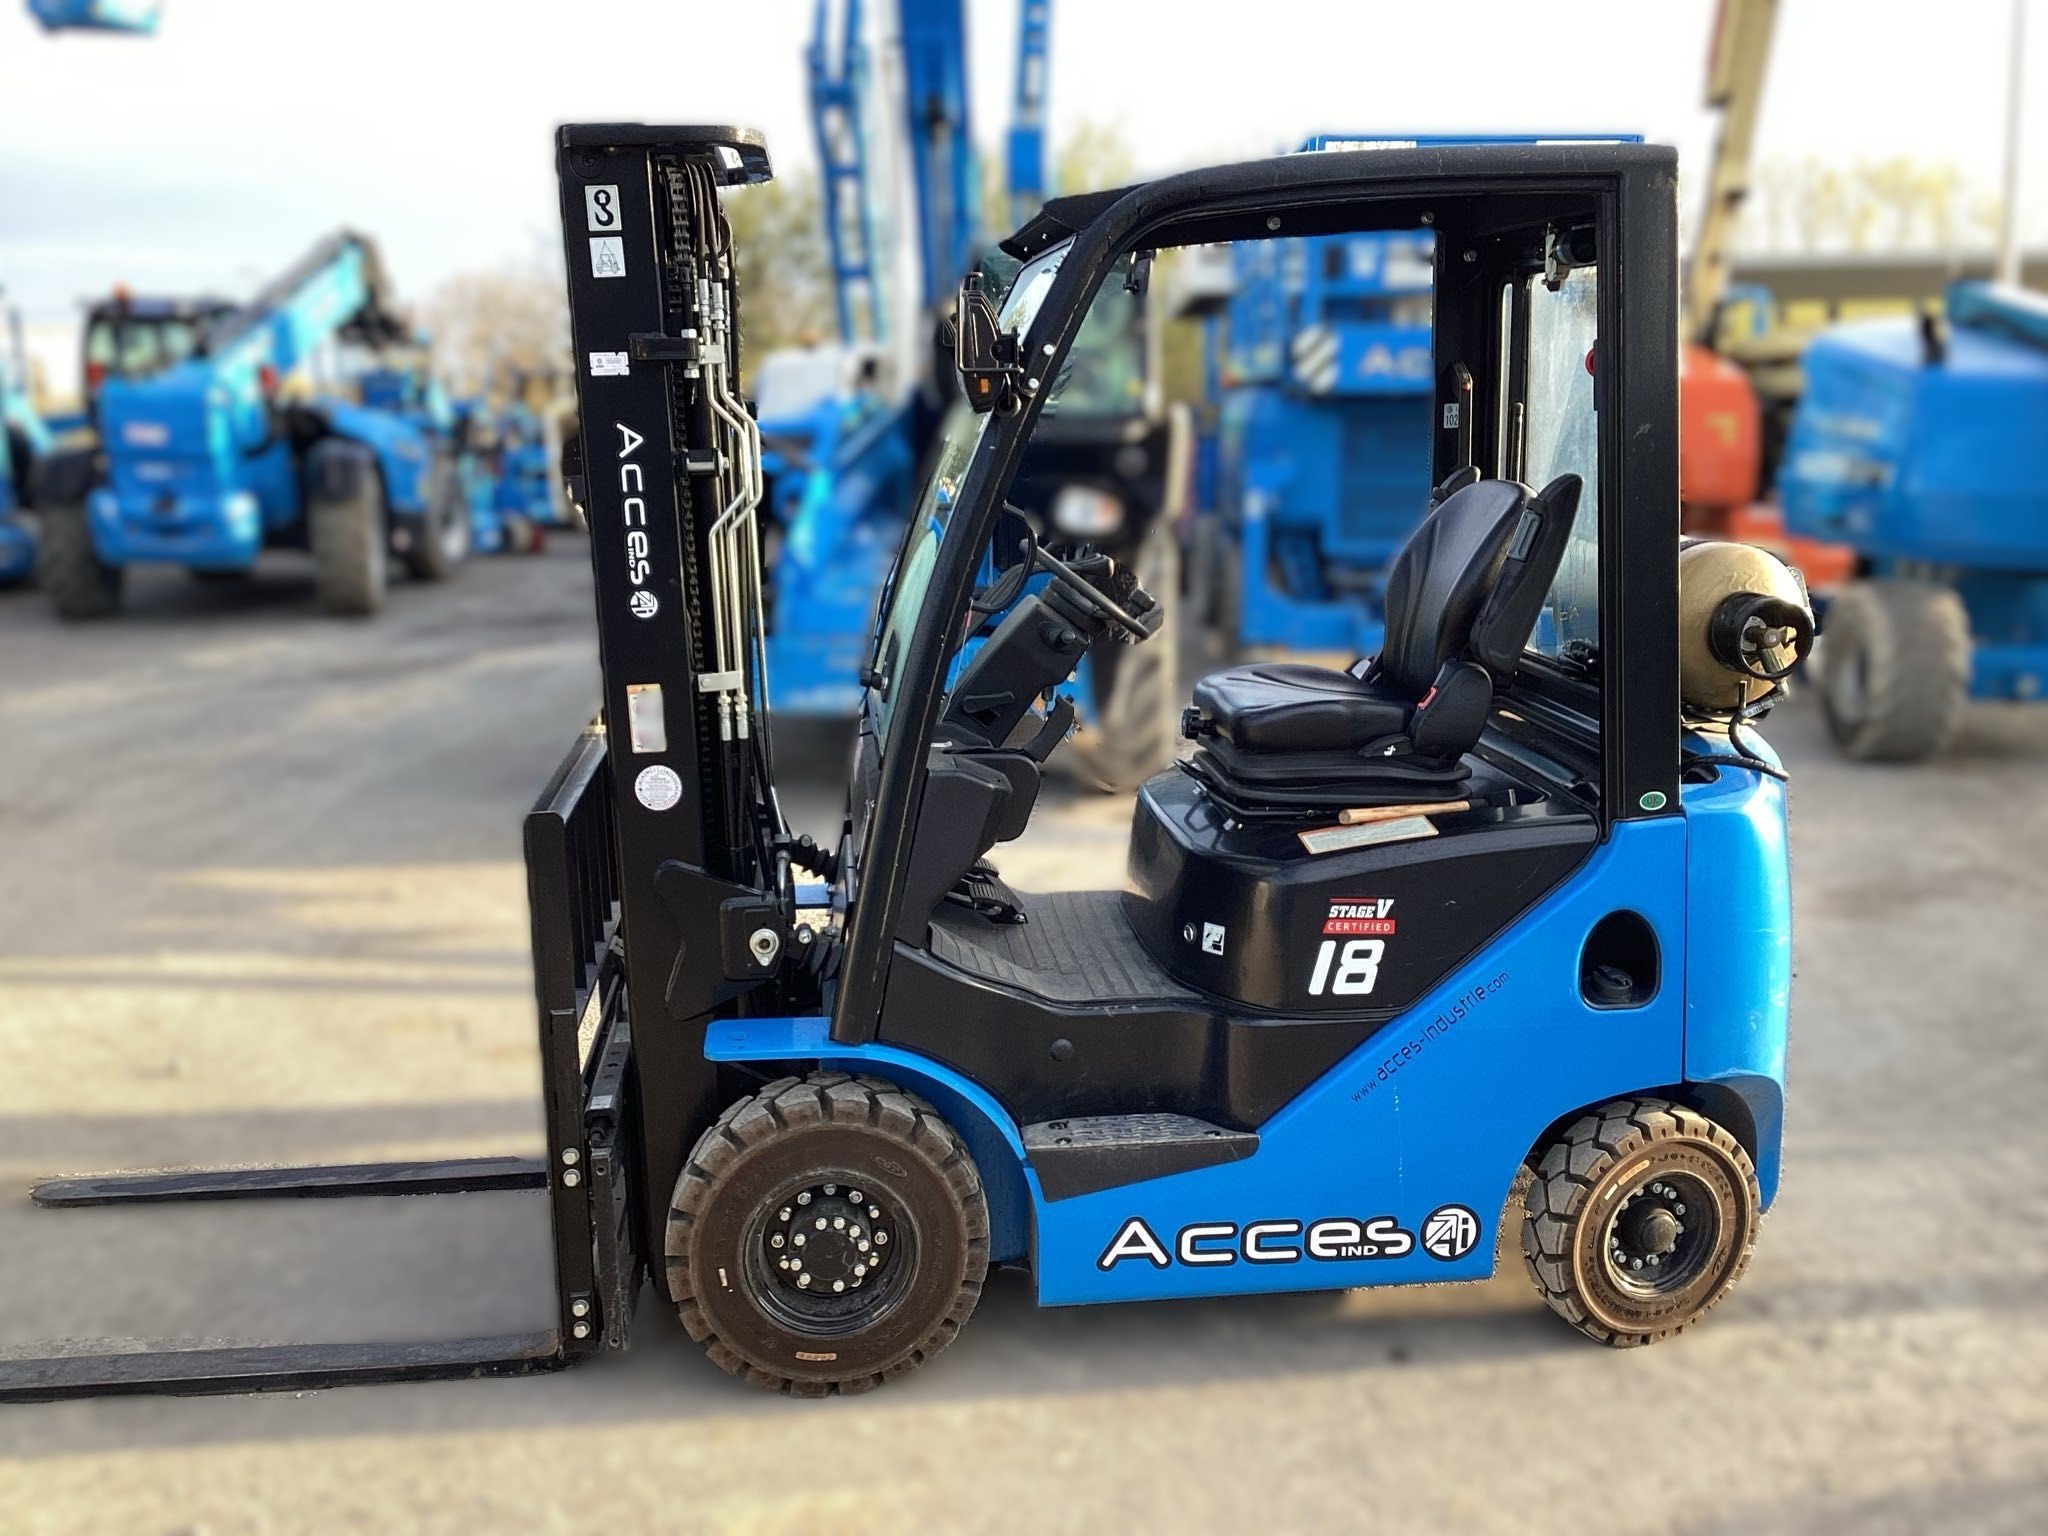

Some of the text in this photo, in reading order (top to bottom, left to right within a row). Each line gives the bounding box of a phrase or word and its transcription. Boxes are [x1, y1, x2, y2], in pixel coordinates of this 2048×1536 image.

[627, 547, 636, 568] IND
[1327, 904, 1376, 919] STAGE
[1327, 922, 1391, 932] CERTIFIED
[1308, 939, 1386, 995] 18
[1351, 972, 1510, 1102] www.acces-industrie.com
[1340, 1245, 1379, 1257] IND
